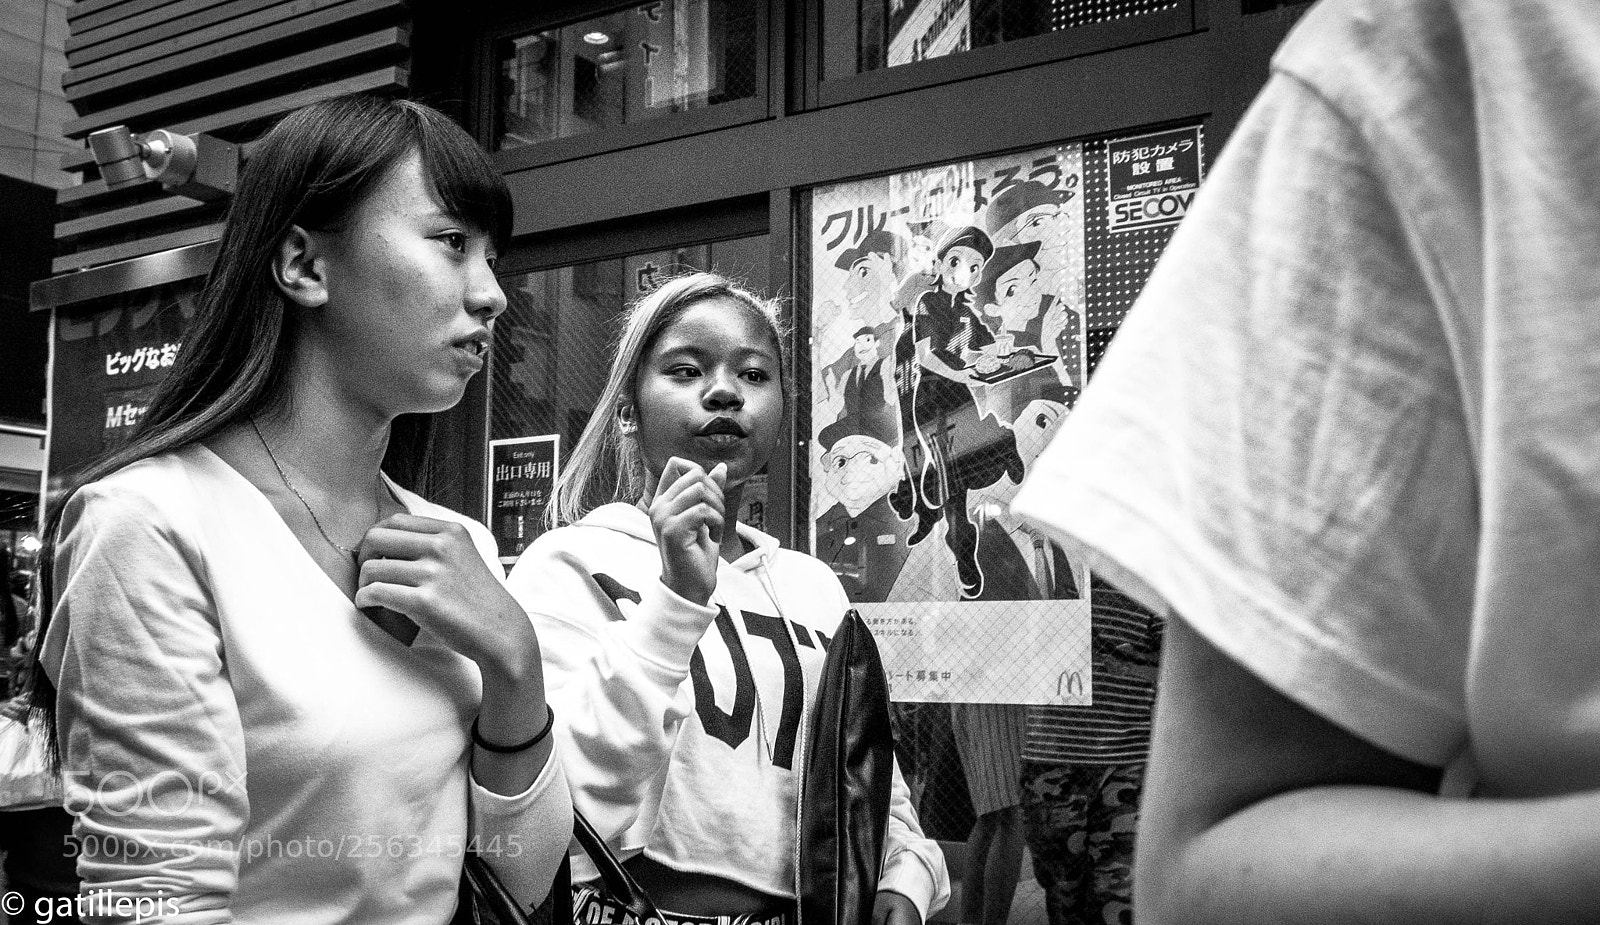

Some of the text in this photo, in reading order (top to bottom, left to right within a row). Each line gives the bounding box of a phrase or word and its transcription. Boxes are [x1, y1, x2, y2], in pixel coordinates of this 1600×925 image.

[1112, 139, 1194, 165] 防犯カメラ
[496, 461, 551, 482] 出口専用
